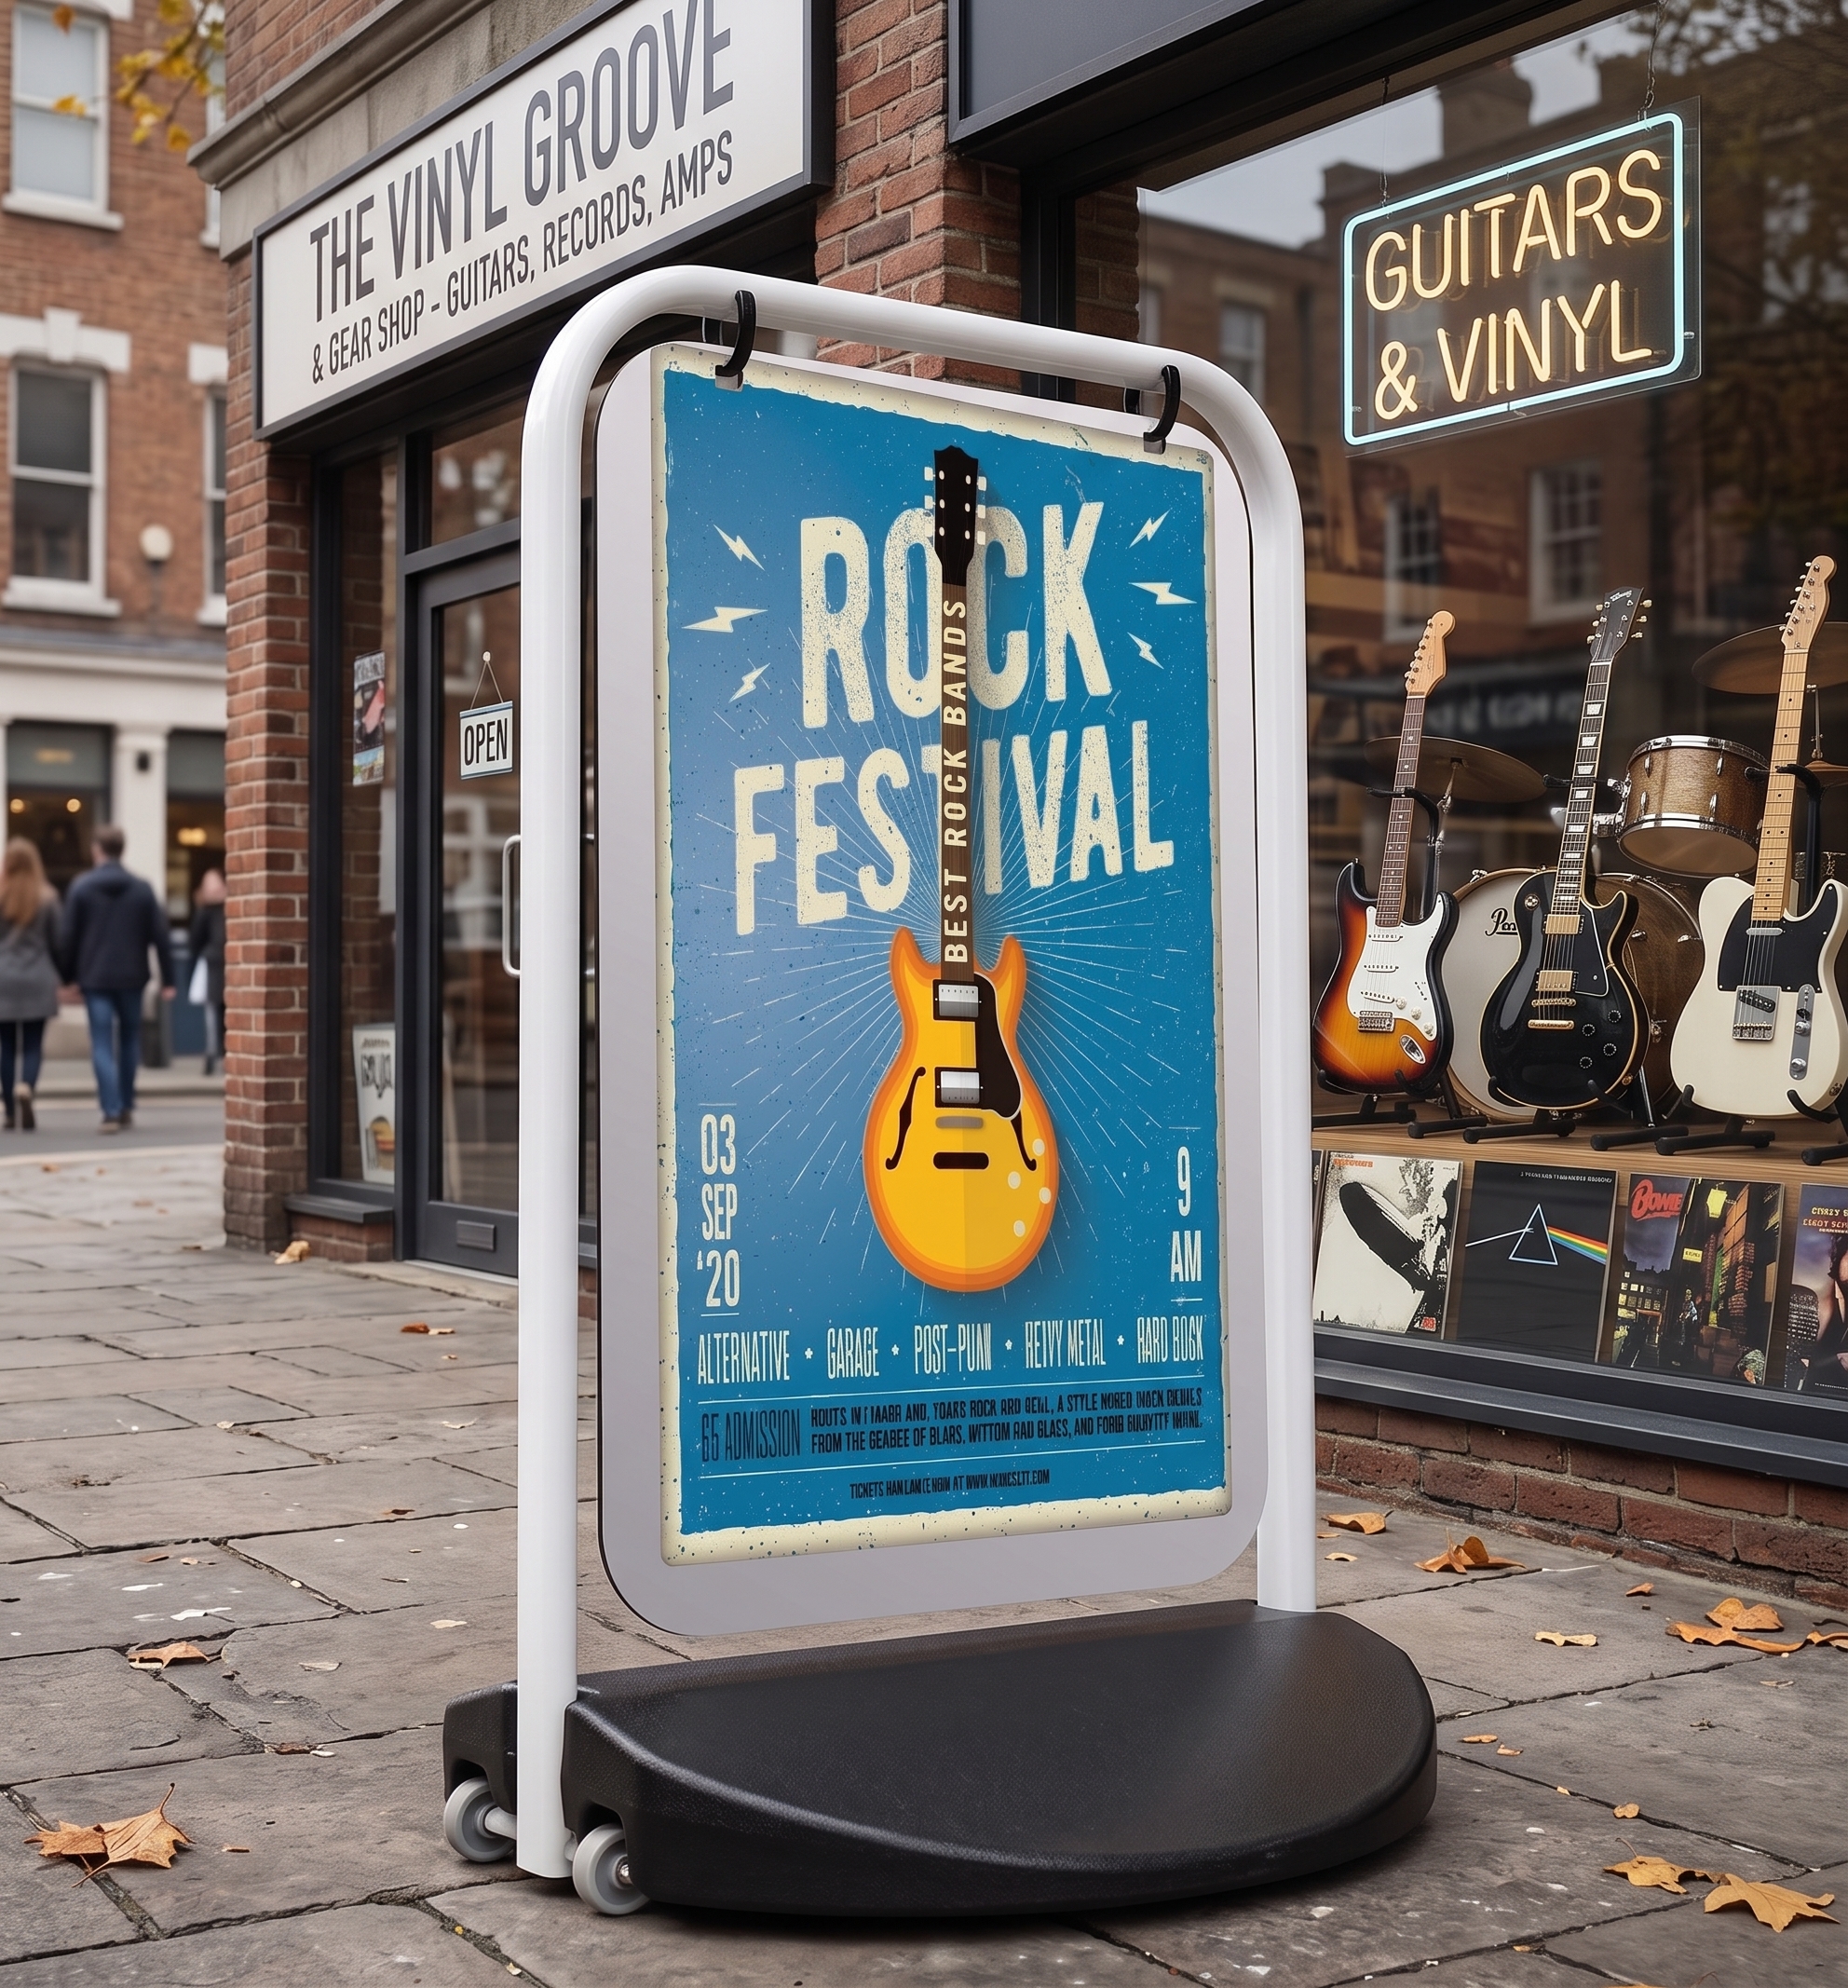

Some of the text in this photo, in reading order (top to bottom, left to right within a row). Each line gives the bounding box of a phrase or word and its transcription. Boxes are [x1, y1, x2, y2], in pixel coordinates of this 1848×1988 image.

[309, 0, 734, 323] THE VINYL GROOVE
[312, 343, 324, 385] &
[329, 320, 373, 374] GEAR
[377, 288, 425, 352] SHOP
[446, 234, 535, 319] GUITARS,
[542, 174, 653, 268] RECORDS,
[659, 129, 732, 216] AMPS
[1365, 149, 1662, 311] GUITARS
[1374, 280, 1652, 420] & VINYL
[801, 501, 1113, 728] ROCK
[465, 718, 507, 766] OPEN
[943, 599, 968, 963] BEST ROCK BANDS
[700, 1114, 737, 1175] 03
[701, 1183, 738, 1241] SEP
[1176, 1146, 1191, 1217] 9
[697, 1248, 741, 1307] '20
[1170, 1231, 1203, 1283] AM
[698, 1330, 790, 1384] ALTERNATIVE
[827, 1327, 879, 1379] GARAGE
[1067, 1319, 1106, 1367] METAL
[1057, 1395, 1064, 1413] A
[1067, 1393, 1097, 1412] STYLE
[725, 1409, 800, 1461] ADMISSION
[811, 1433, 842, 1453] FROM
[846, 1431, 865, 1451] THE
[913, 1426, 926, 1447] OF
[1074, 1417, 1094, 1437] AND
[953, 1475, 964, 1491] AT
